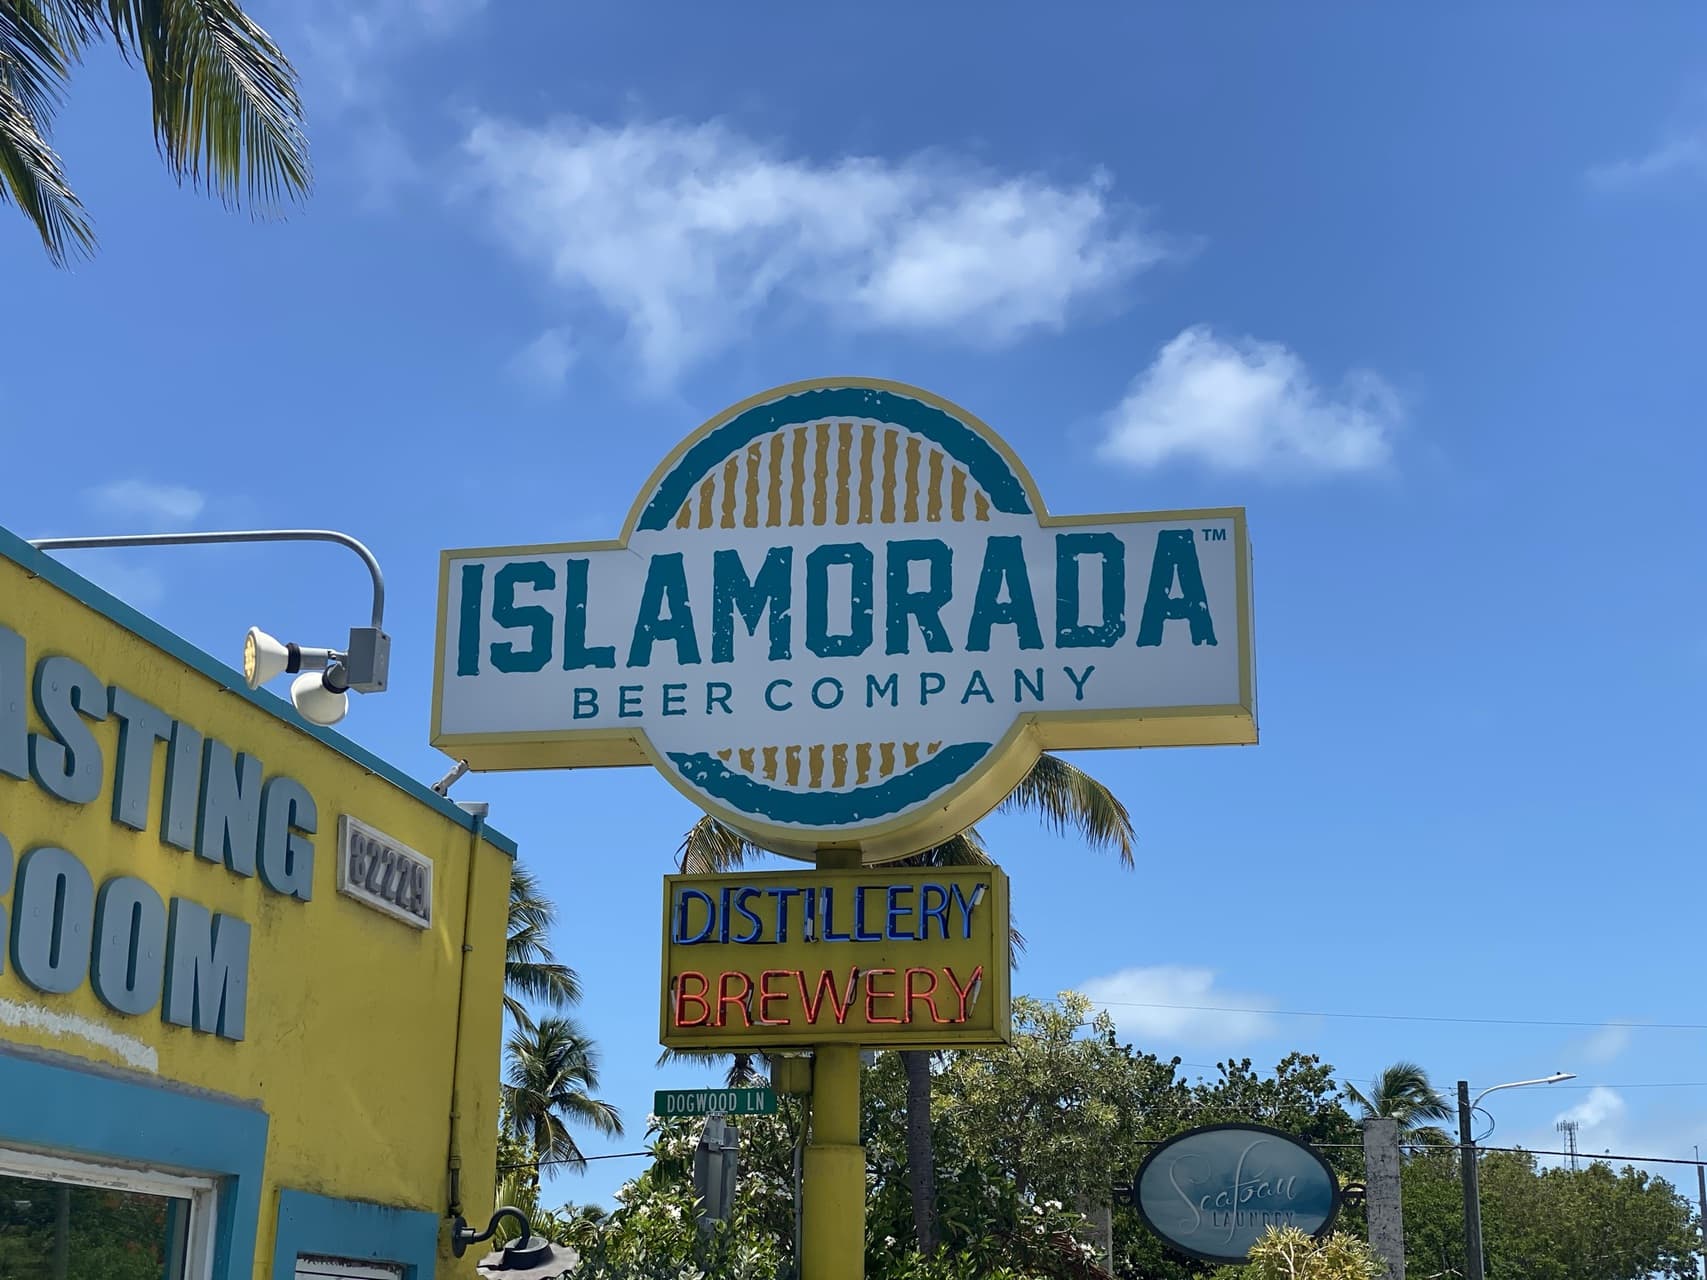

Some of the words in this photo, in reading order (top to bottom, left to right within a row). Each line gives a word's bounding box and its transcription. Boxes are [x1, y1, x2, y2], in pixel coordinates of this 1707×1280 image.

[457, 529, 1218, 677] ISLAMORADA
[572, 681, 734, 720] BEER
[764, 665, 1096, 712] COMPANY
[350, 832, 427, 914] 82229
[0, 831, 252, 1041] OOM
[672, 884, 987, 944] DISTILLERY
[674, 965, 984, 1027] BREWERY
[666, 1092, 738, 1114] DOGWOOD
[746, 1091, 765, 1111] LN
